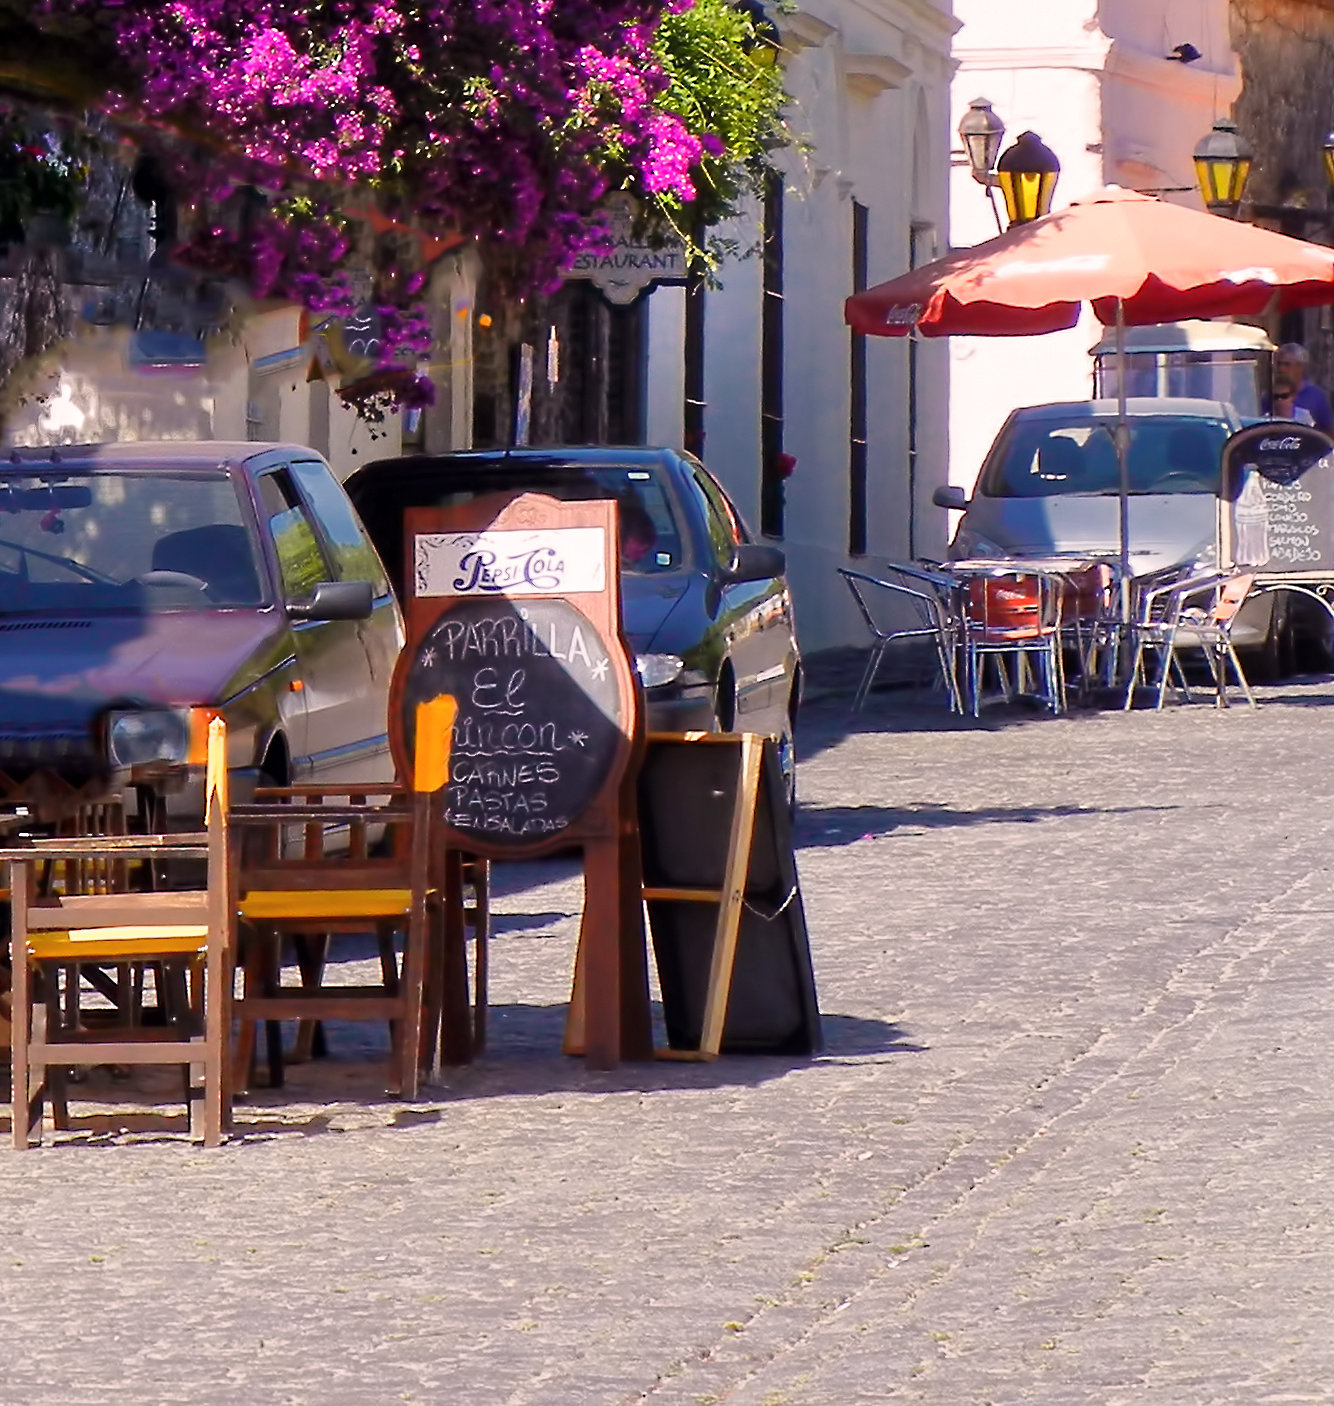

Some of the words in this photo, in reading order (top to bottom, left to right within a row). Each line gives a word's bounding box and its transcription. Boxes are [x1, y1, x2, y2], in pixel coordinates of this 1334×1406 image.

[574, 253, 678, 270] ESTAURANT
[452, 761, 559, 787] CARNES
[448, 785, 548, 813] PASTAS
